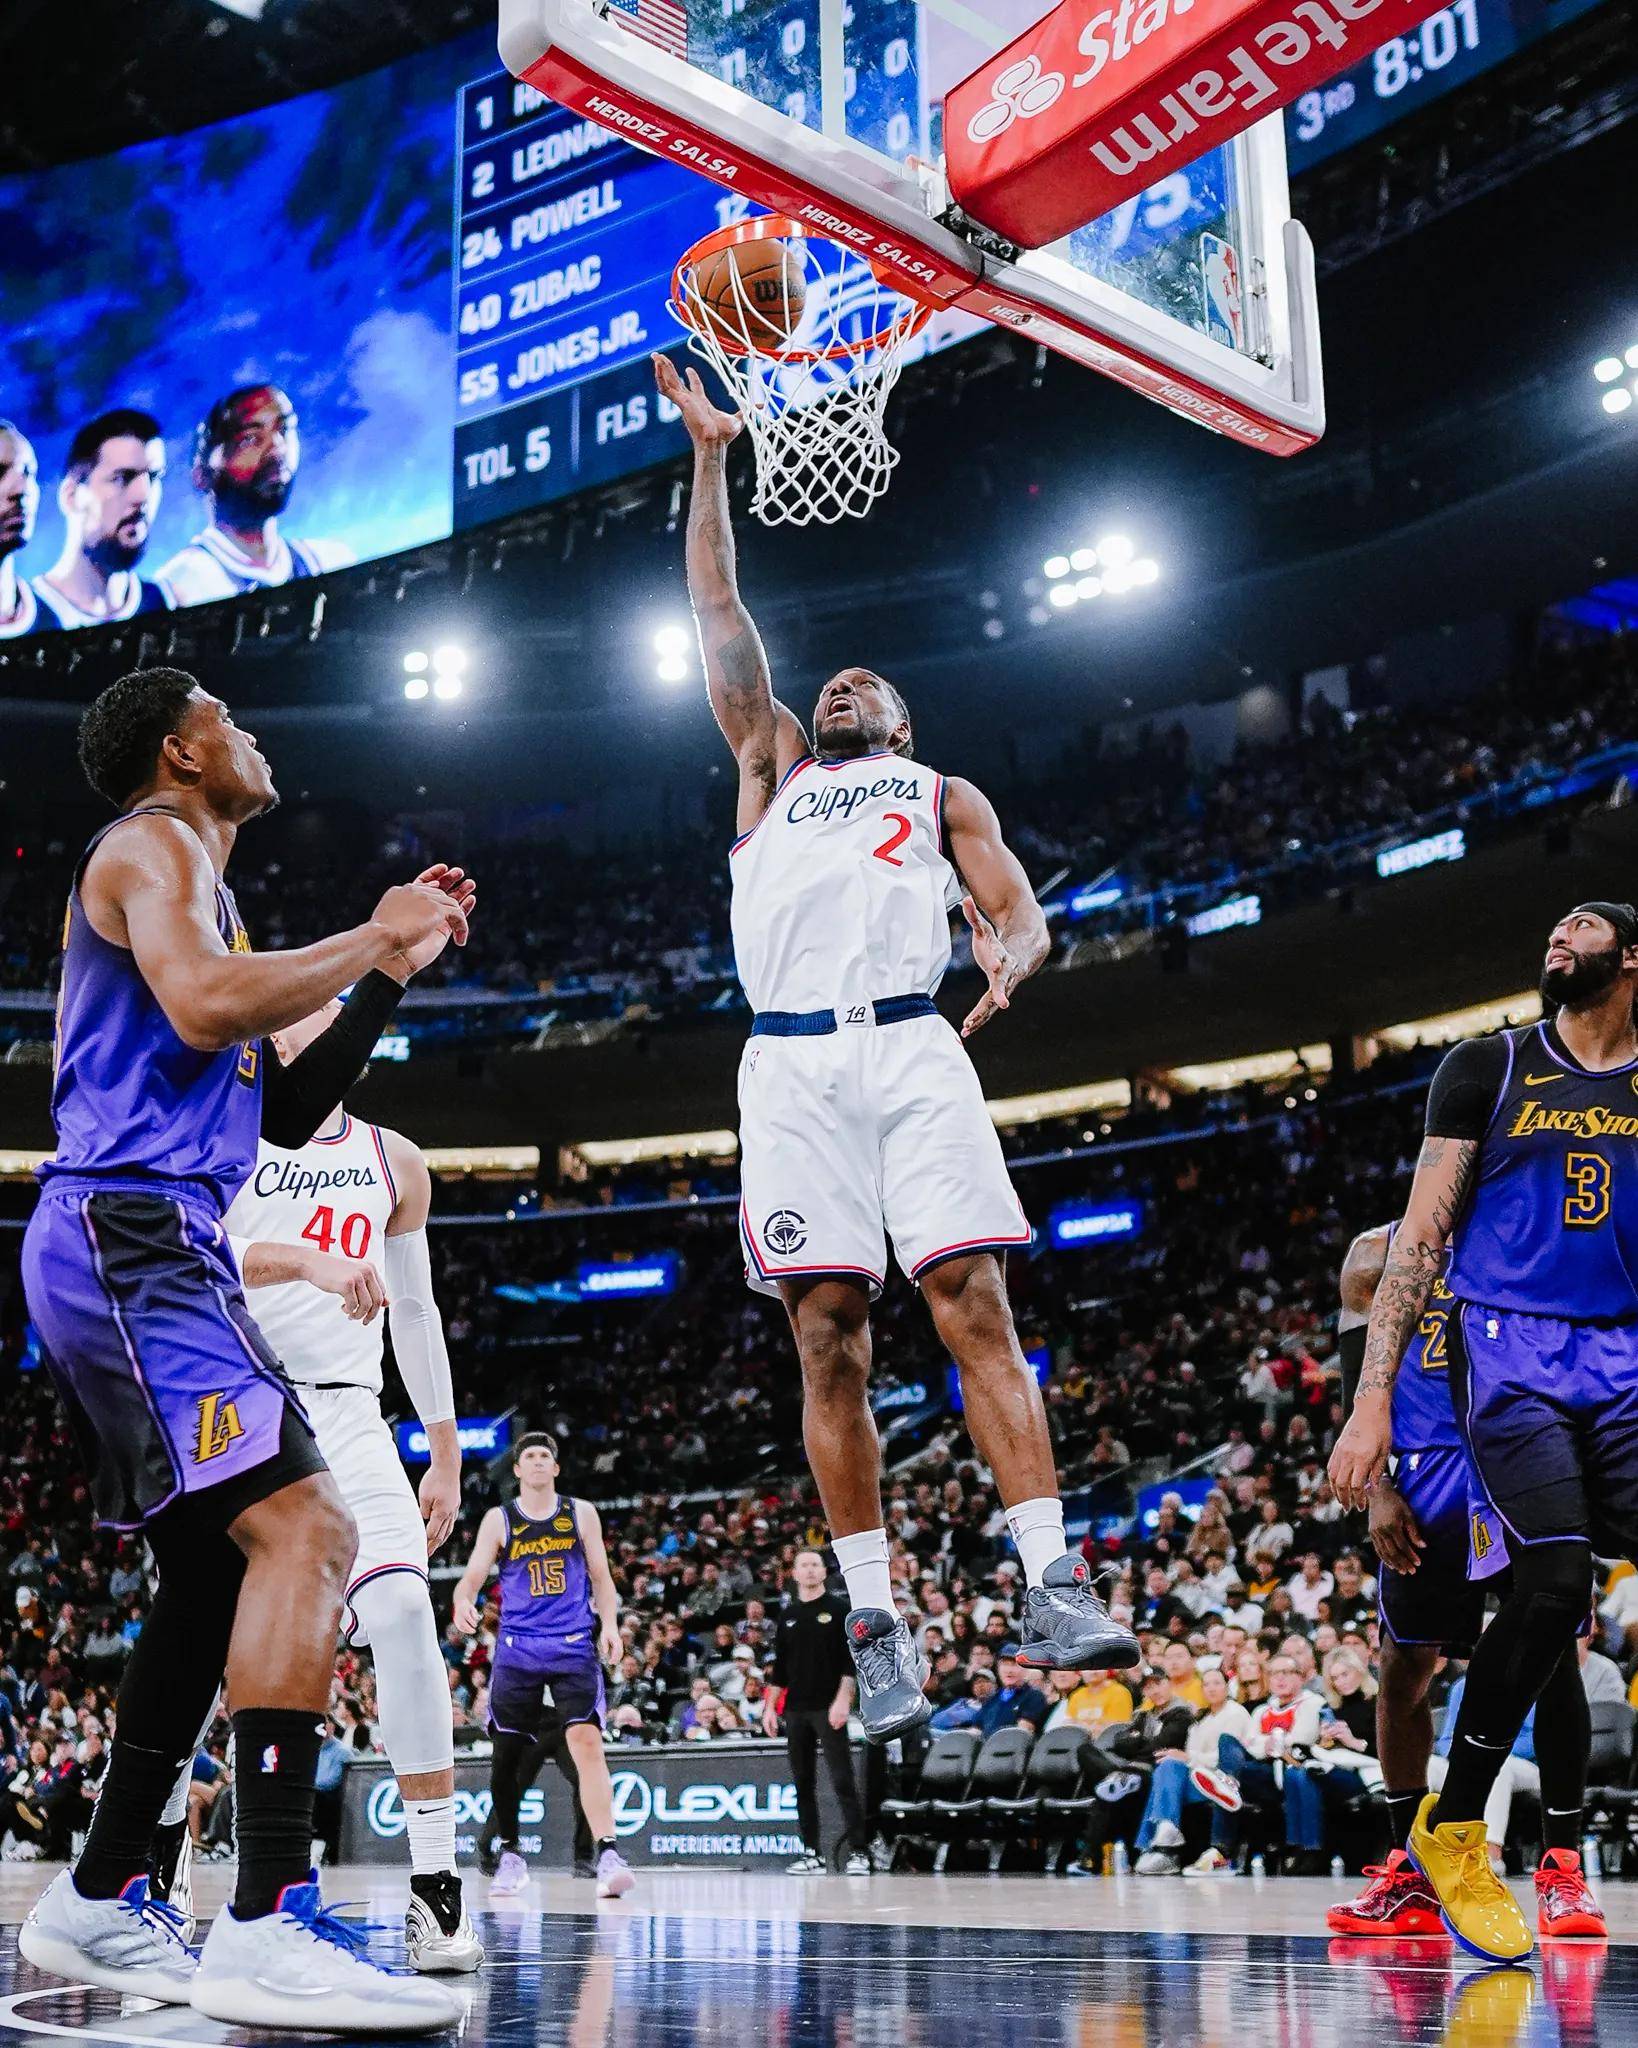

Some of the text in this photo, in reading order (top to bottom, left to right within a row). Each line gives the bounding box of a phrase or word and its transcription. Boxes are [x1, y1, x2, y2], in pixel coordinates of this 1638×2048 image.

[1072, 0, 1195, 88] Sta
[1374, 0, 1480, 97] 8:01
[474, 97, 494, 130] 1
[585, 96, 739, 180] HERDEZ SALSA
[472, 162, 495, 198] 2
[461, 180, 623, 269] 24 POWELL
[799, 204, 937, 282] HERDEZ SALSA
[460, 294, 501, 335] 40
[509, 254, 602, 320] ZUBAC
[460, 310, 648, 405] 55 JONES JR.
[463, 444, 516, 490] TOL
[524, 426, 552, 472] 5
[596, 396, 649, 446] FLS
[1160, 384, 1271, 443] HERDEZ SALSA
[787, 777, 923, 824] Clippers
[873, 813, 912, 867] 2
[254, 1161, 378, 1199] Clippers
[1565, 1152, 1611, 1225] 3
[301, 1205, 372, 1259] 40
[192, 1391, 244, 1464] LA
[528, 1557, 567, 1597] 15
[651, 1834, 804, 1856] EXPERIENCE AMAZIN
